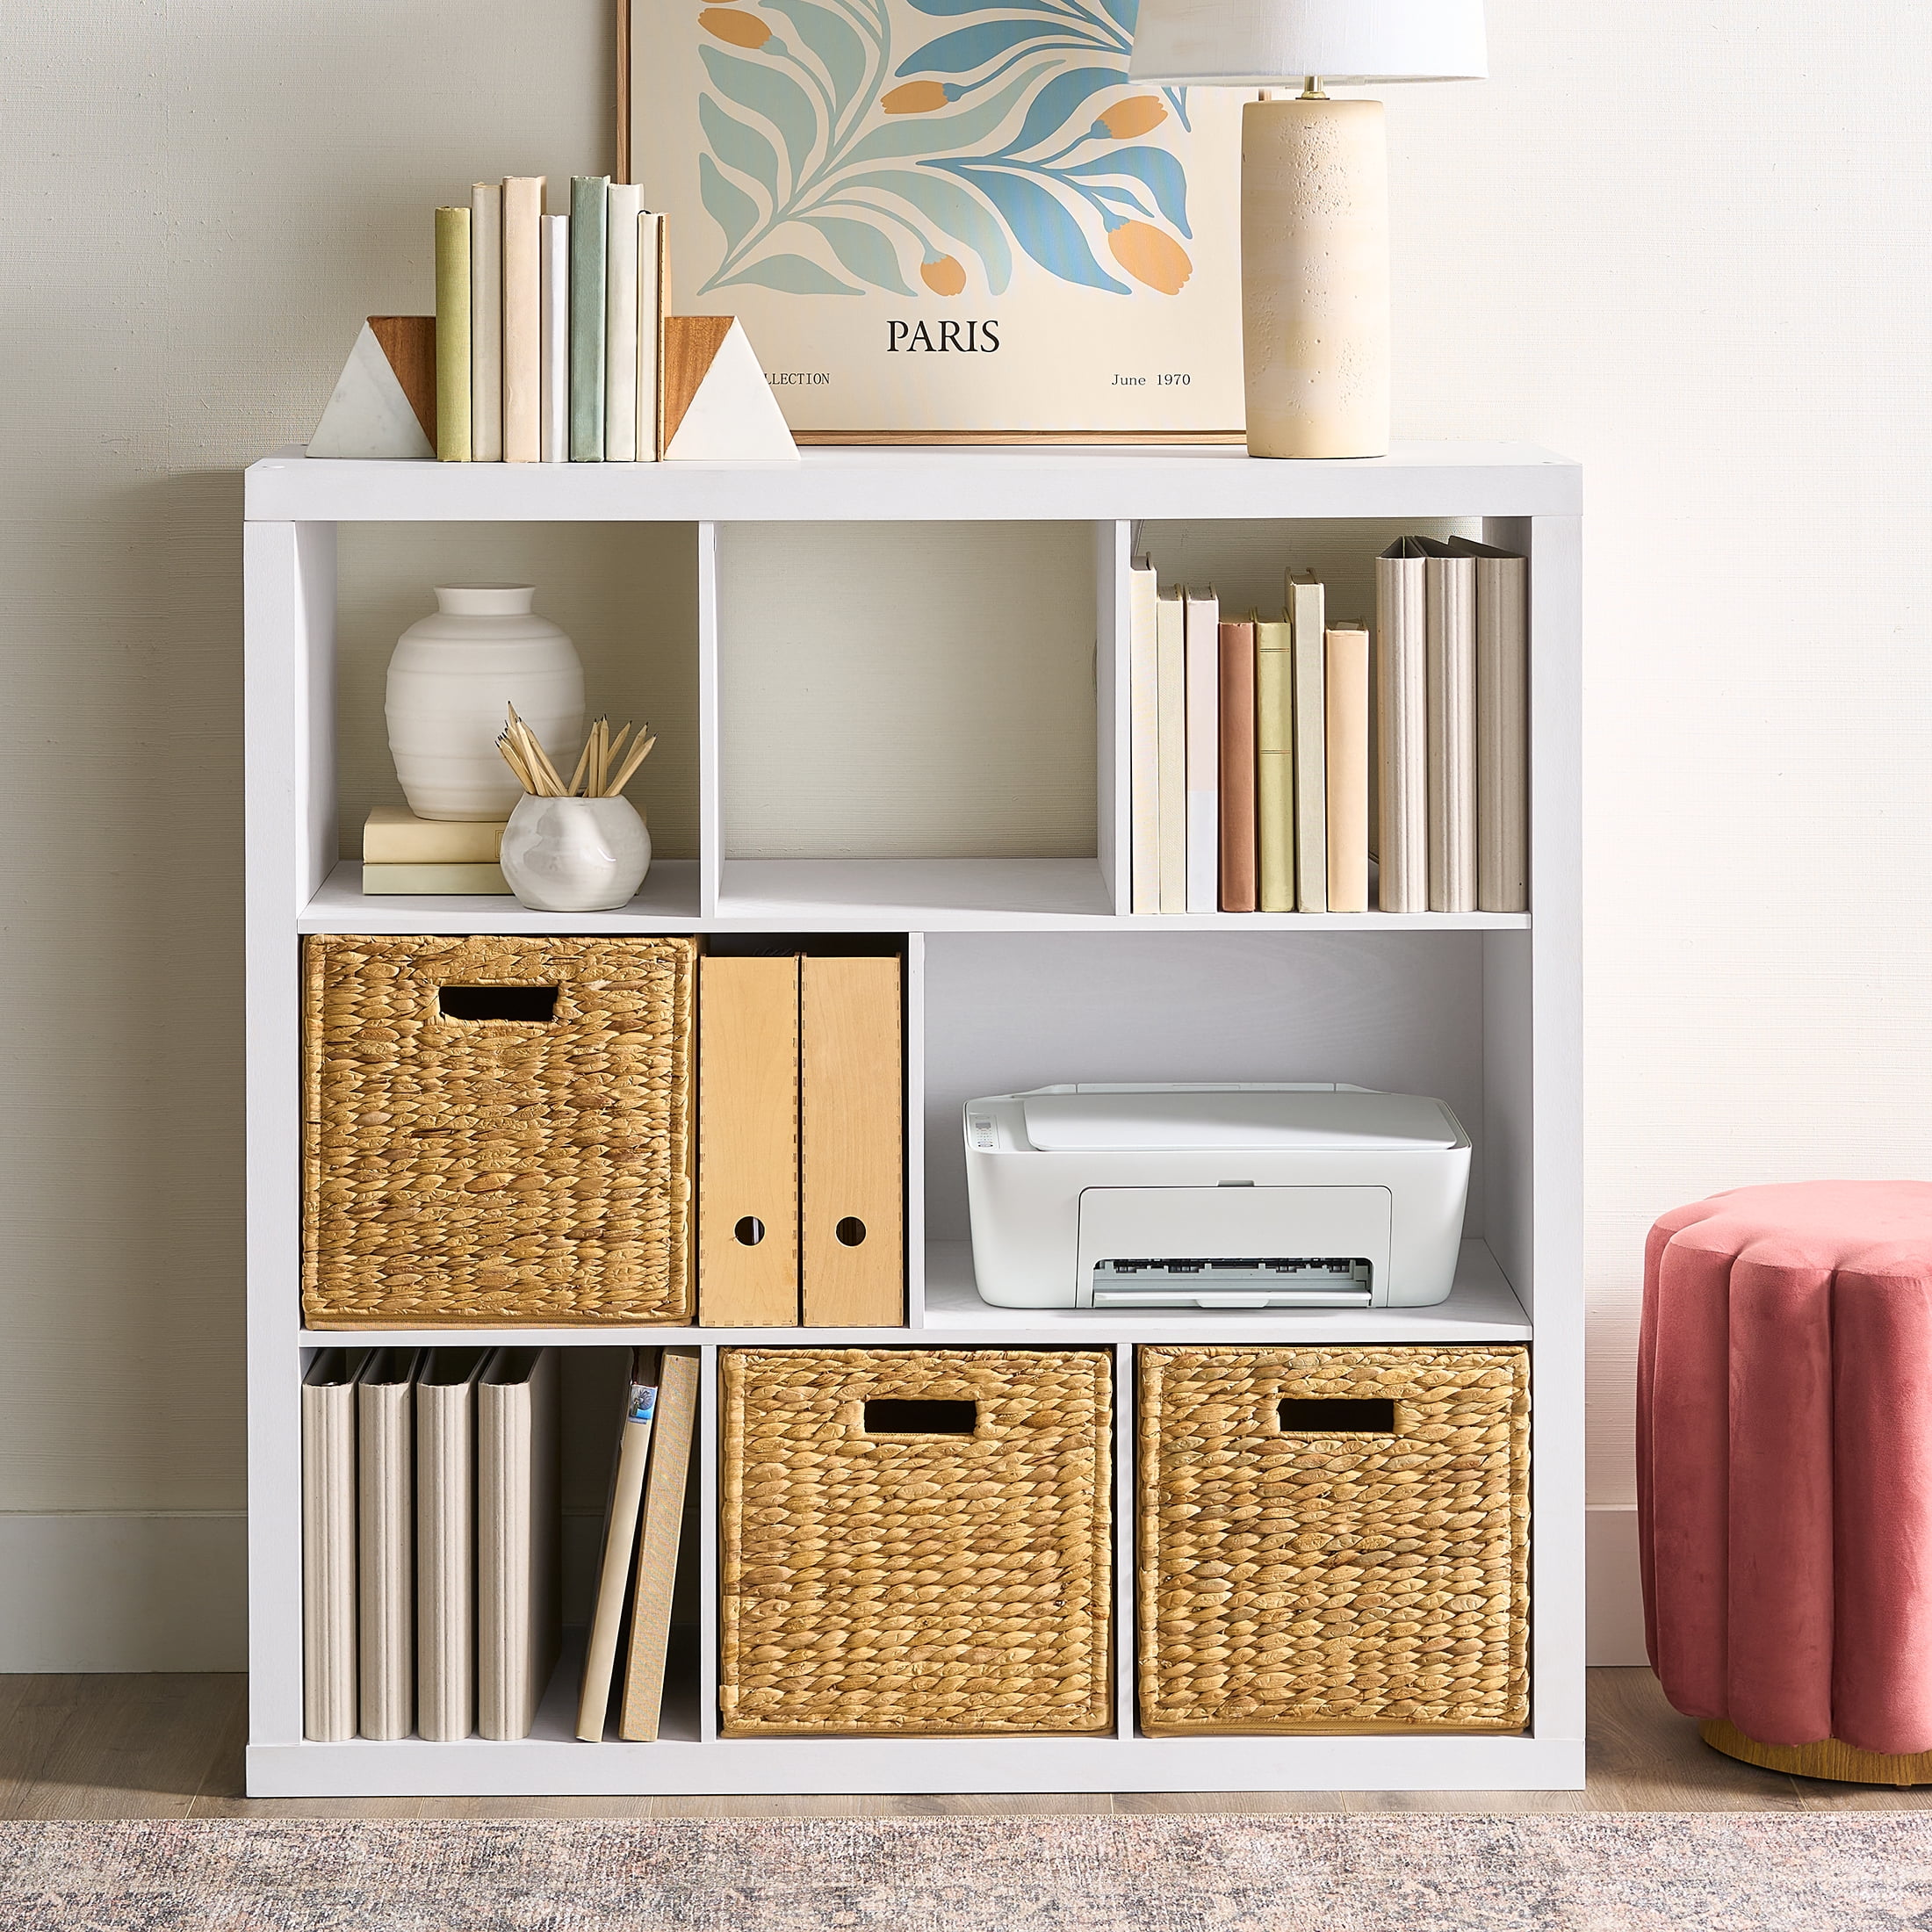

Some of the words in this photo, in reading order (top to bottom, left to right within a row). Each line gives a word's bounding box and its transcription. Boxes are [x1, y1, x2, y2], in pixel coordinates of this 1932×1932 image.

[886, 320, 1000, 353] PARIS
[1111, 373, 1146, 386] June
[1157, 373, 1191, 386] 1970
